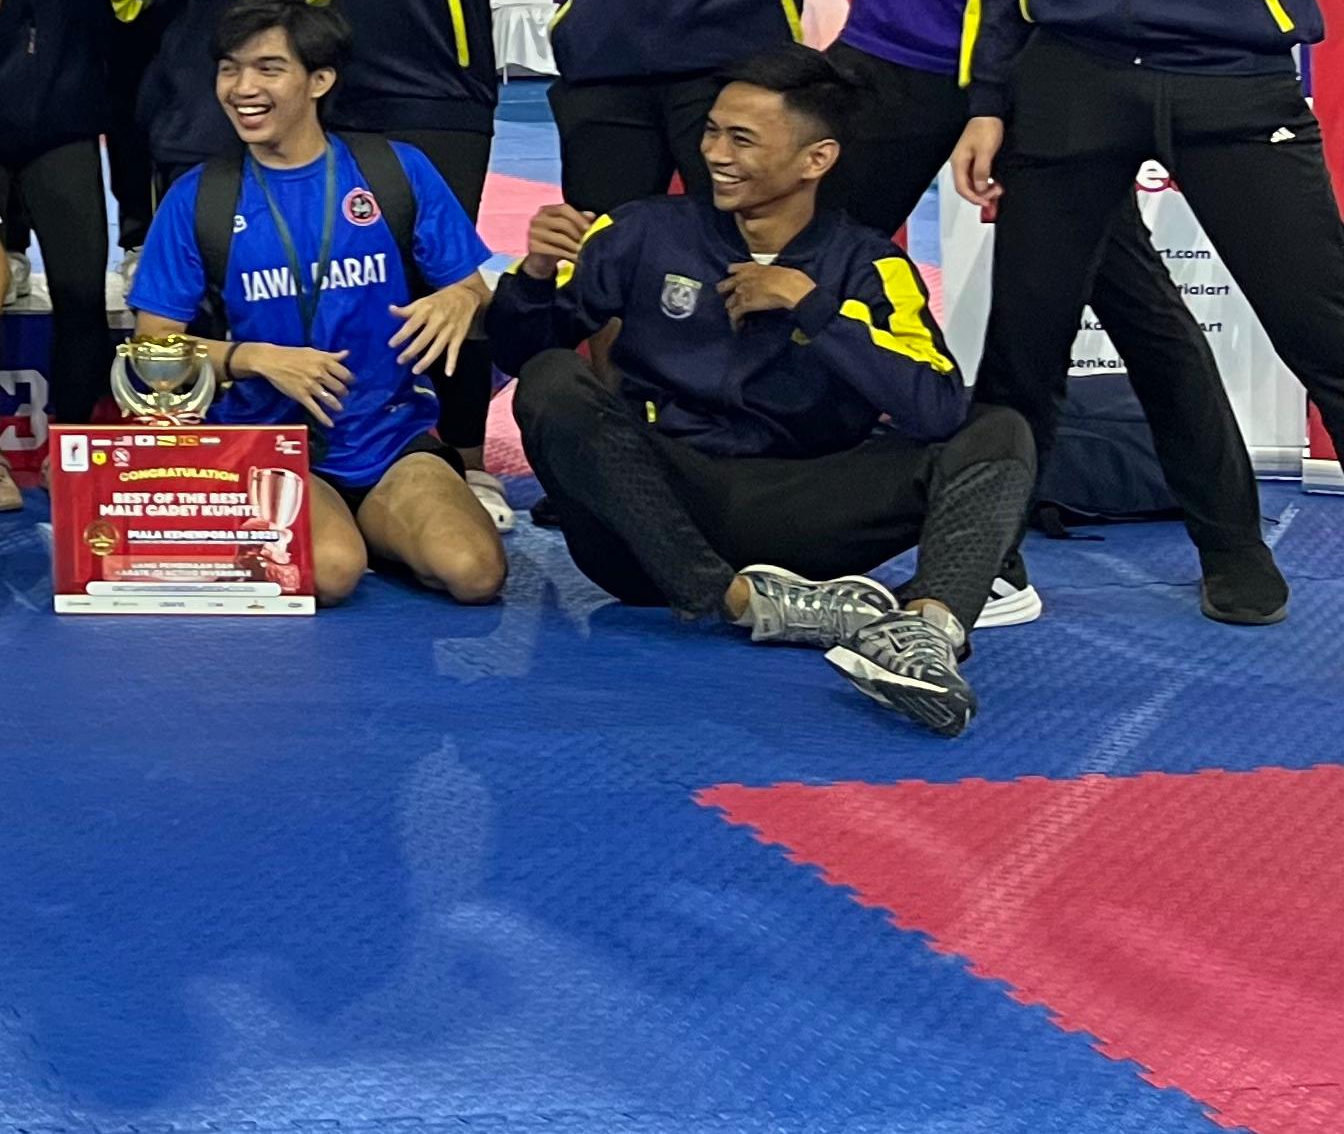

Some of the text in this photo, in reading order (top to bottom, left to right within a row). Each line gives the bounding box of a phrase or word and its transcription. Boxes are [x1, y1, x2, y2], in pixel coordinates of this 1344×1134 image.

[119, 466, 240, 482] CONGRATULATION
[112, 492, 249, 504] BEST OF THE BEST
[99, 504, 260, 516] MALE CADET KUMITE
